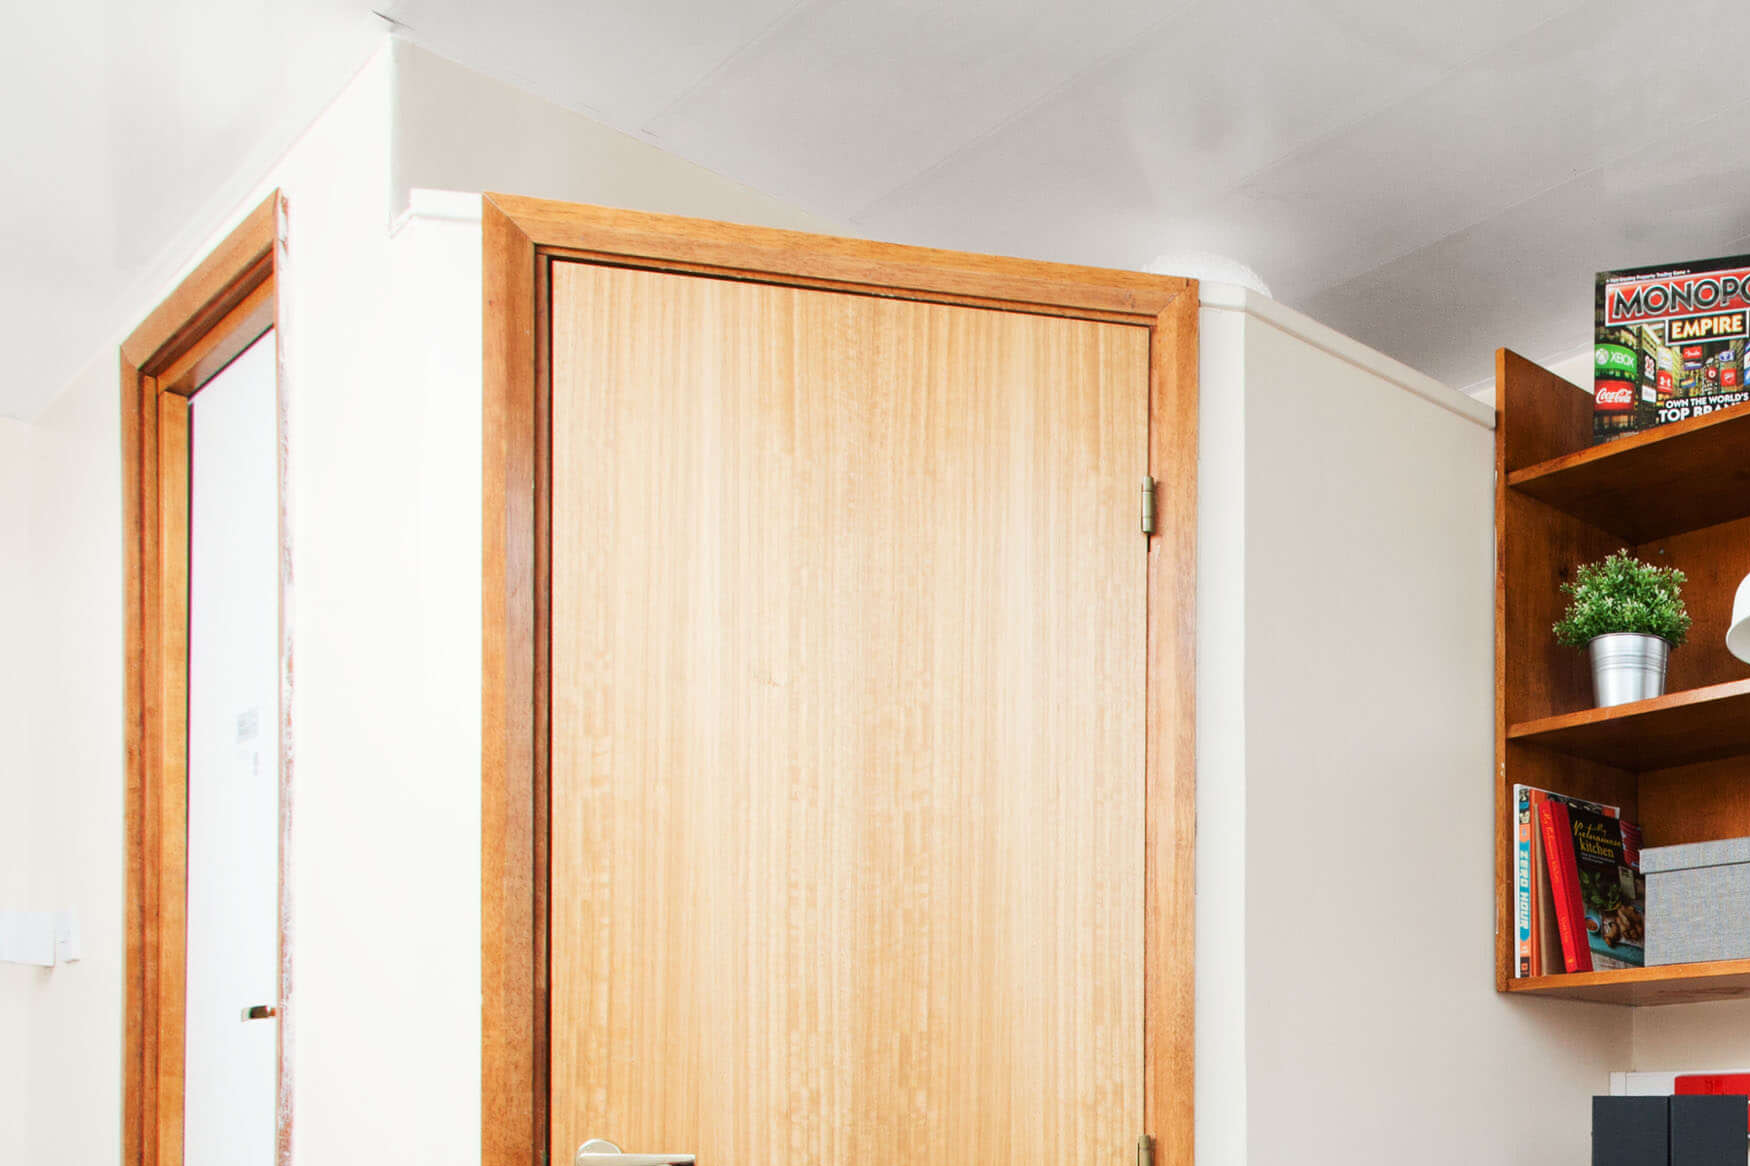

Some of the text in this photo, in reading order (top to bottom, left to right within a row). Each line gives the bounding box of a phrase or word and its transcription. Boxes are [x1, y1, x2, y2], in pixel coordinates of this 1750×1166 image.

[1671, 314, 1743, 340] EMPIRE
[1610, 351, 1634, 368] XBOX
[1665, 392, 1749, 409] OWN THE WORLD'S
[1658, 407, 1690, 422] TOP
[1579, 836, 1615, 858] kitchen
[1519, 850, 1529, 930] ZERO HOUR
